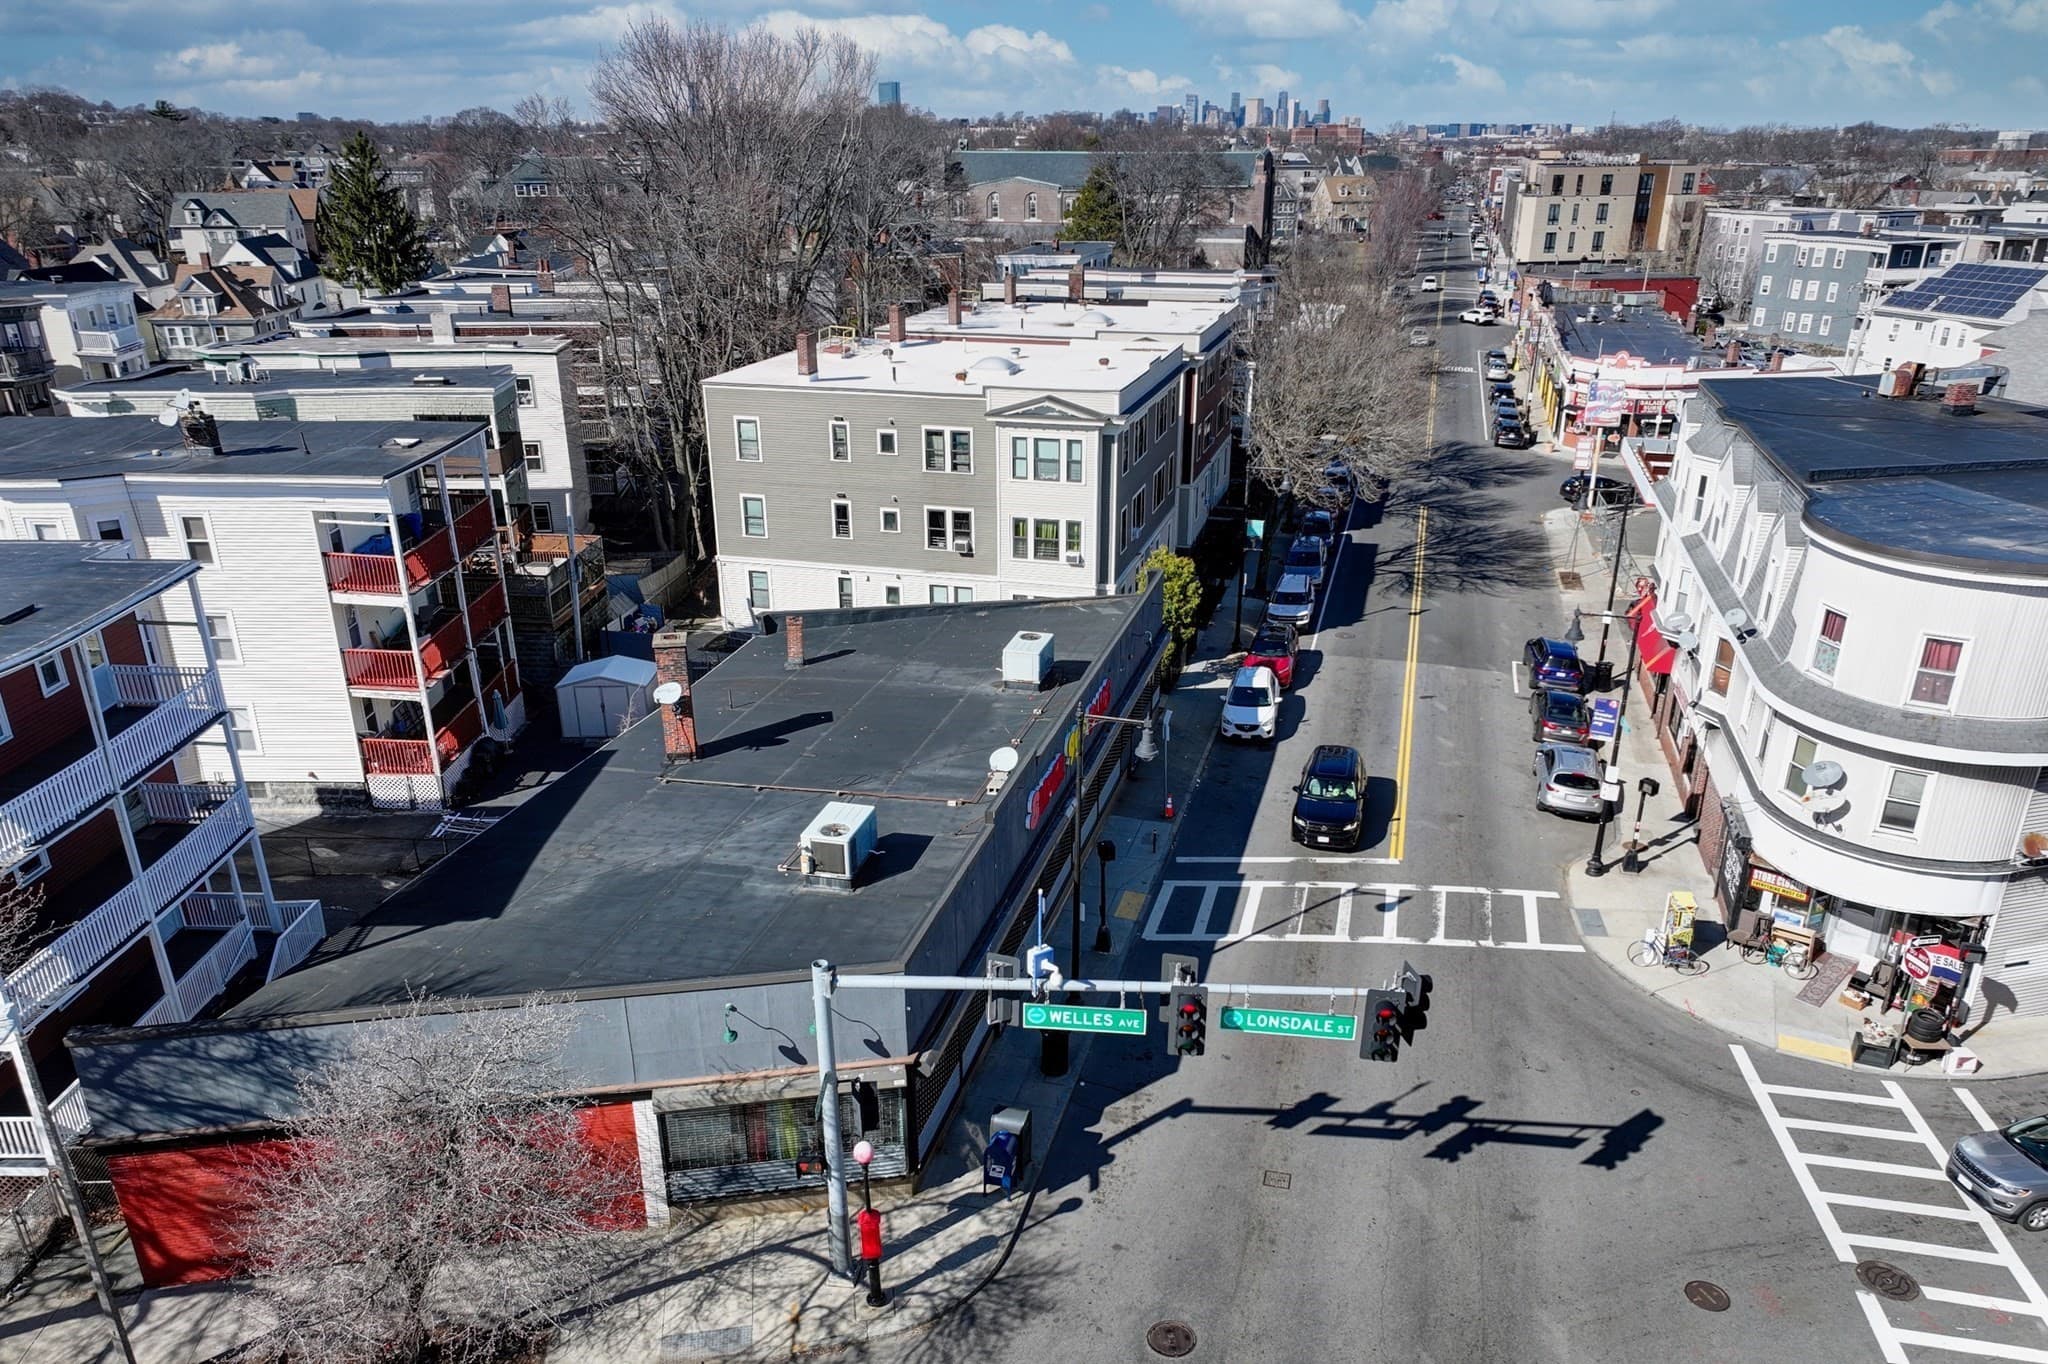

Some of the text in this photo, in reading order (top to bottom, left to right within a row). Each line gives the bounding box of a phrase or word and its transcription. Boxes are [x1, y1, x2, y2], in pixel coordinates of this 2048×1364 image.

[1753, 869, 1776, 884] STORE
[1943, 957, 1965, 971] SALE
[1050, 1011, 1140, 1029] WELLES AVE
[1246, 1014, 1351, 1034] LONSDALE ST
